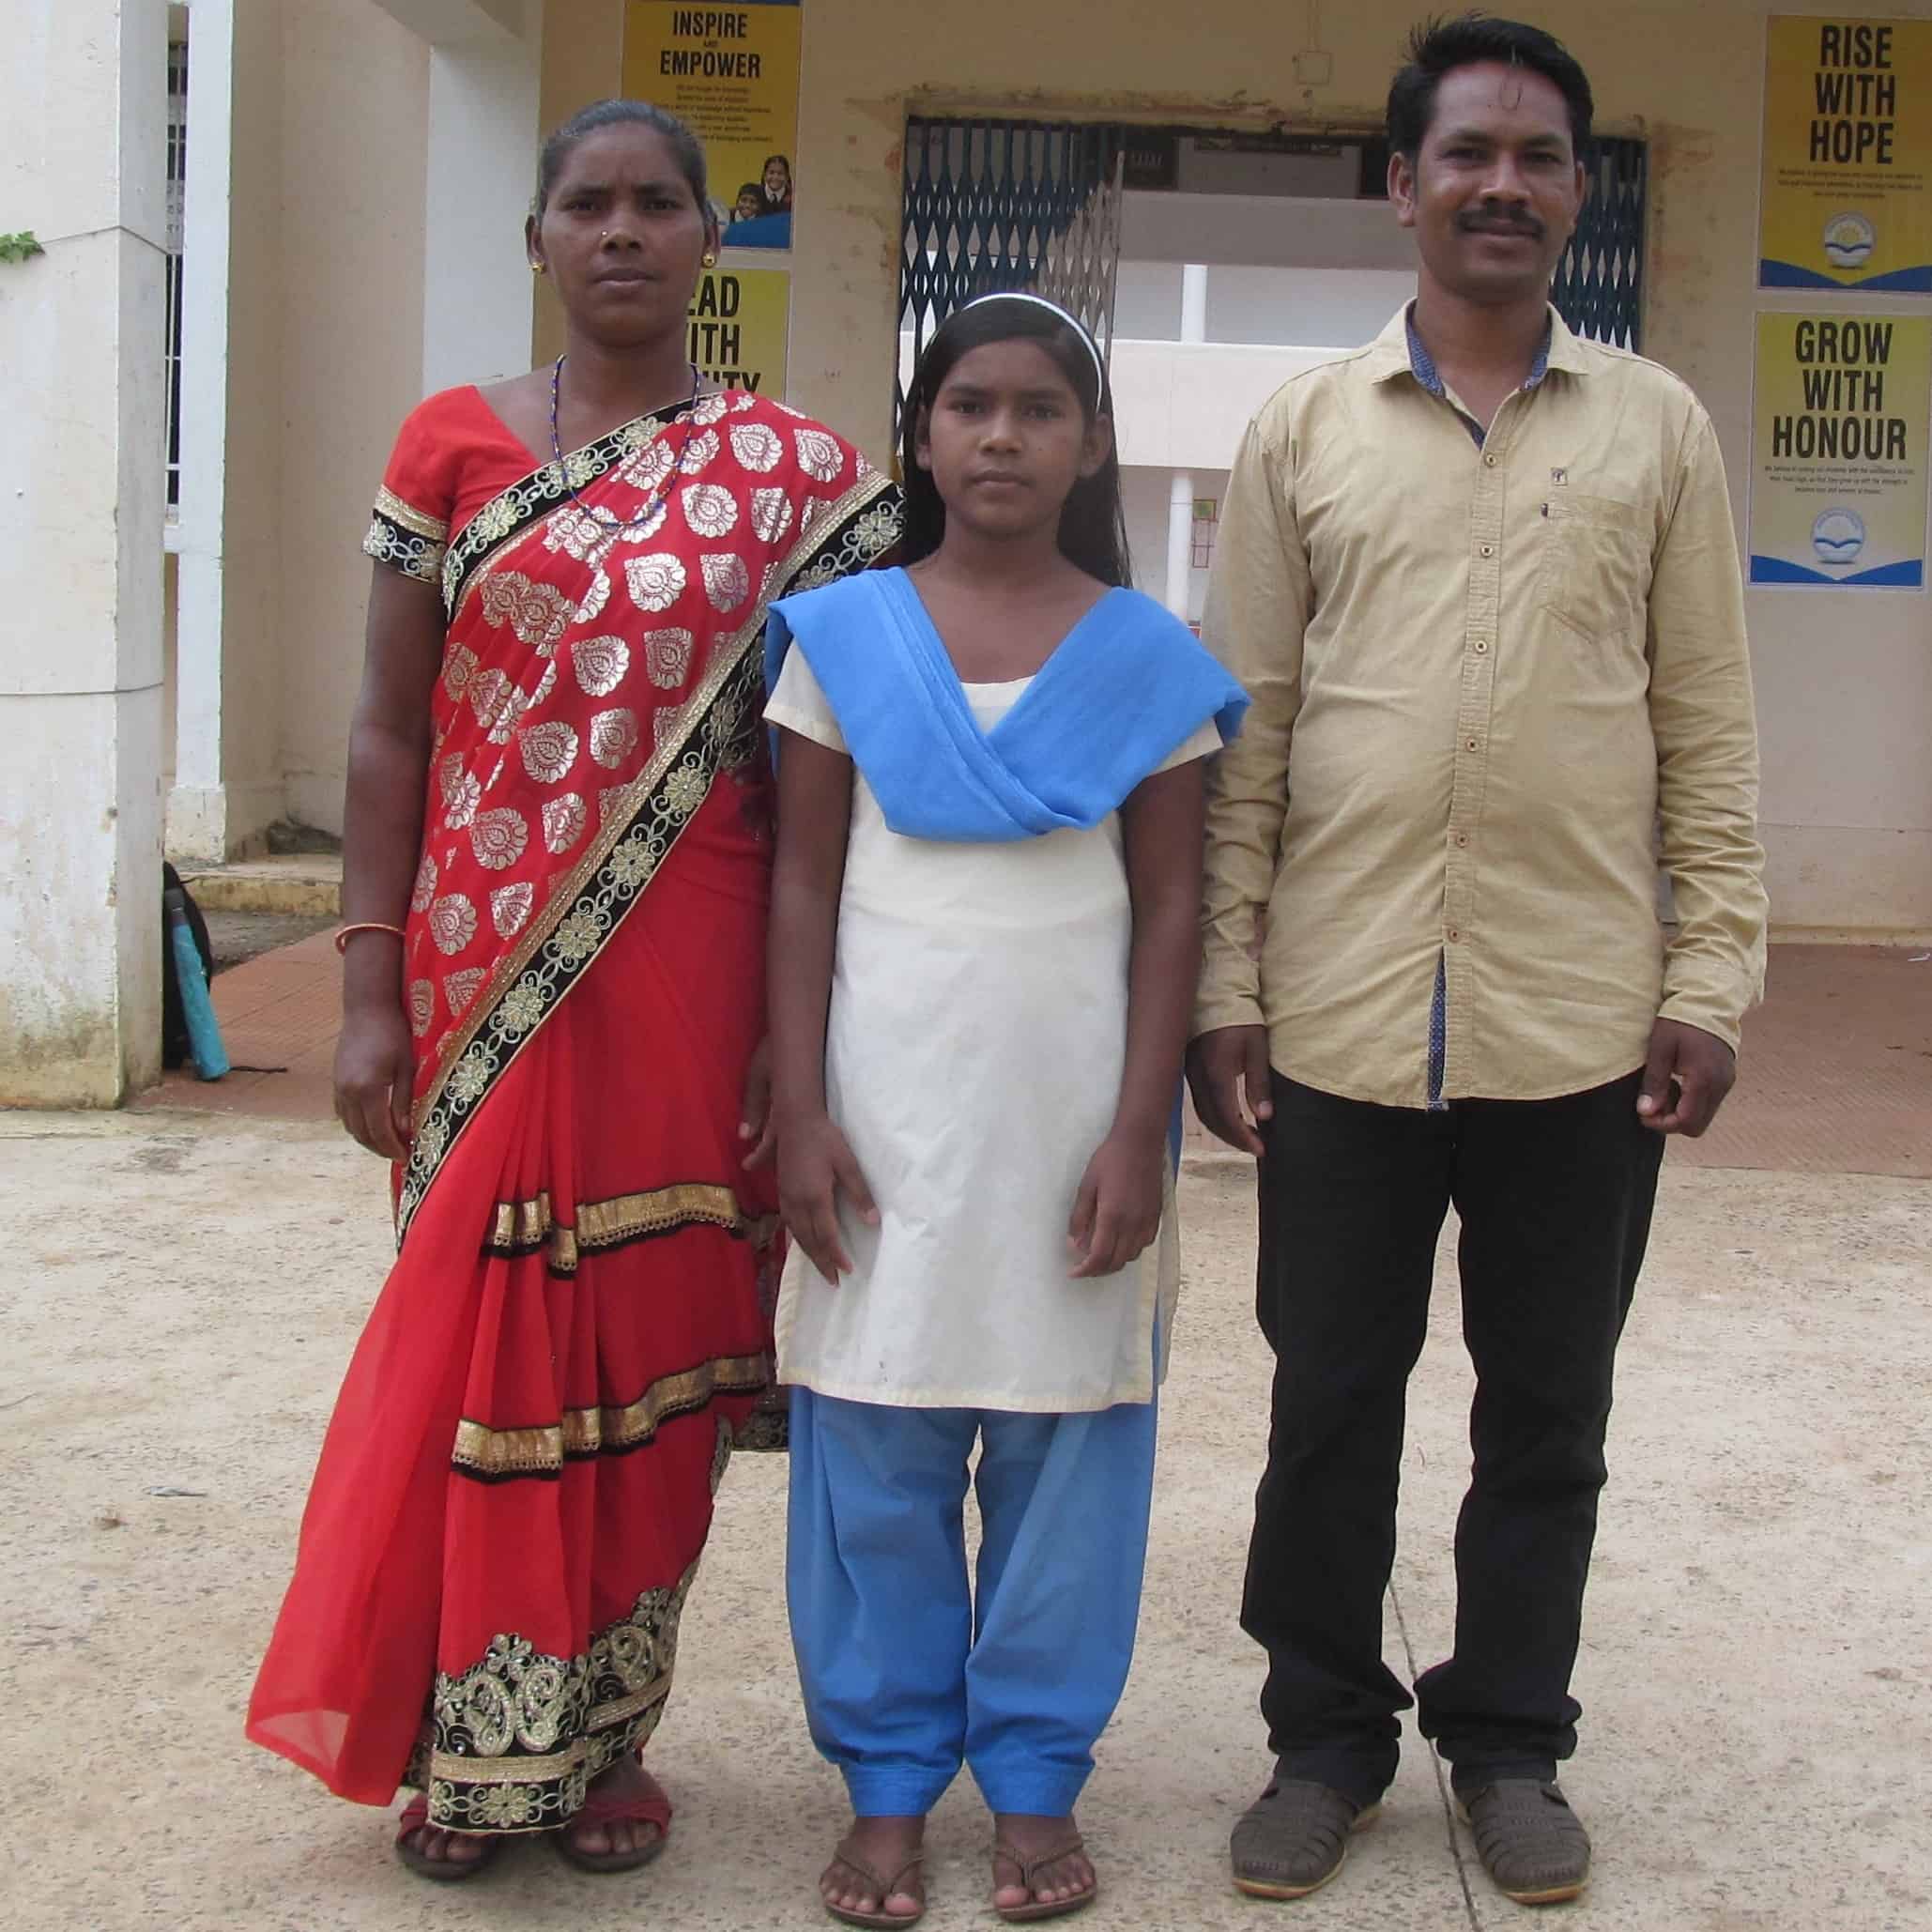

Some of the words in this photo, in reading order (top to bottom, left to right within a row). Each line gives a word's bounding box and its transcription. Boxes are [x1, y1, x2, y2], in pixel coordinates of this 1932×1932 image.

[673, 10, 748, 38] INSPIRE
[660, 51, 761, 78] EMPOWER
[1820, 24, 1894, 69] RISE
[1815, 72, 1895, 116] WITH
[1810, 119, 1894, 164] HOPE
[687, 275, 740, 317] AD
[688, 322, 740, 365] ITH
[1795, 320, 1893, 364] GROW
[1802, 369, 1884, 412] WITH
[1772, 415, 1907, 460] HONOUR
